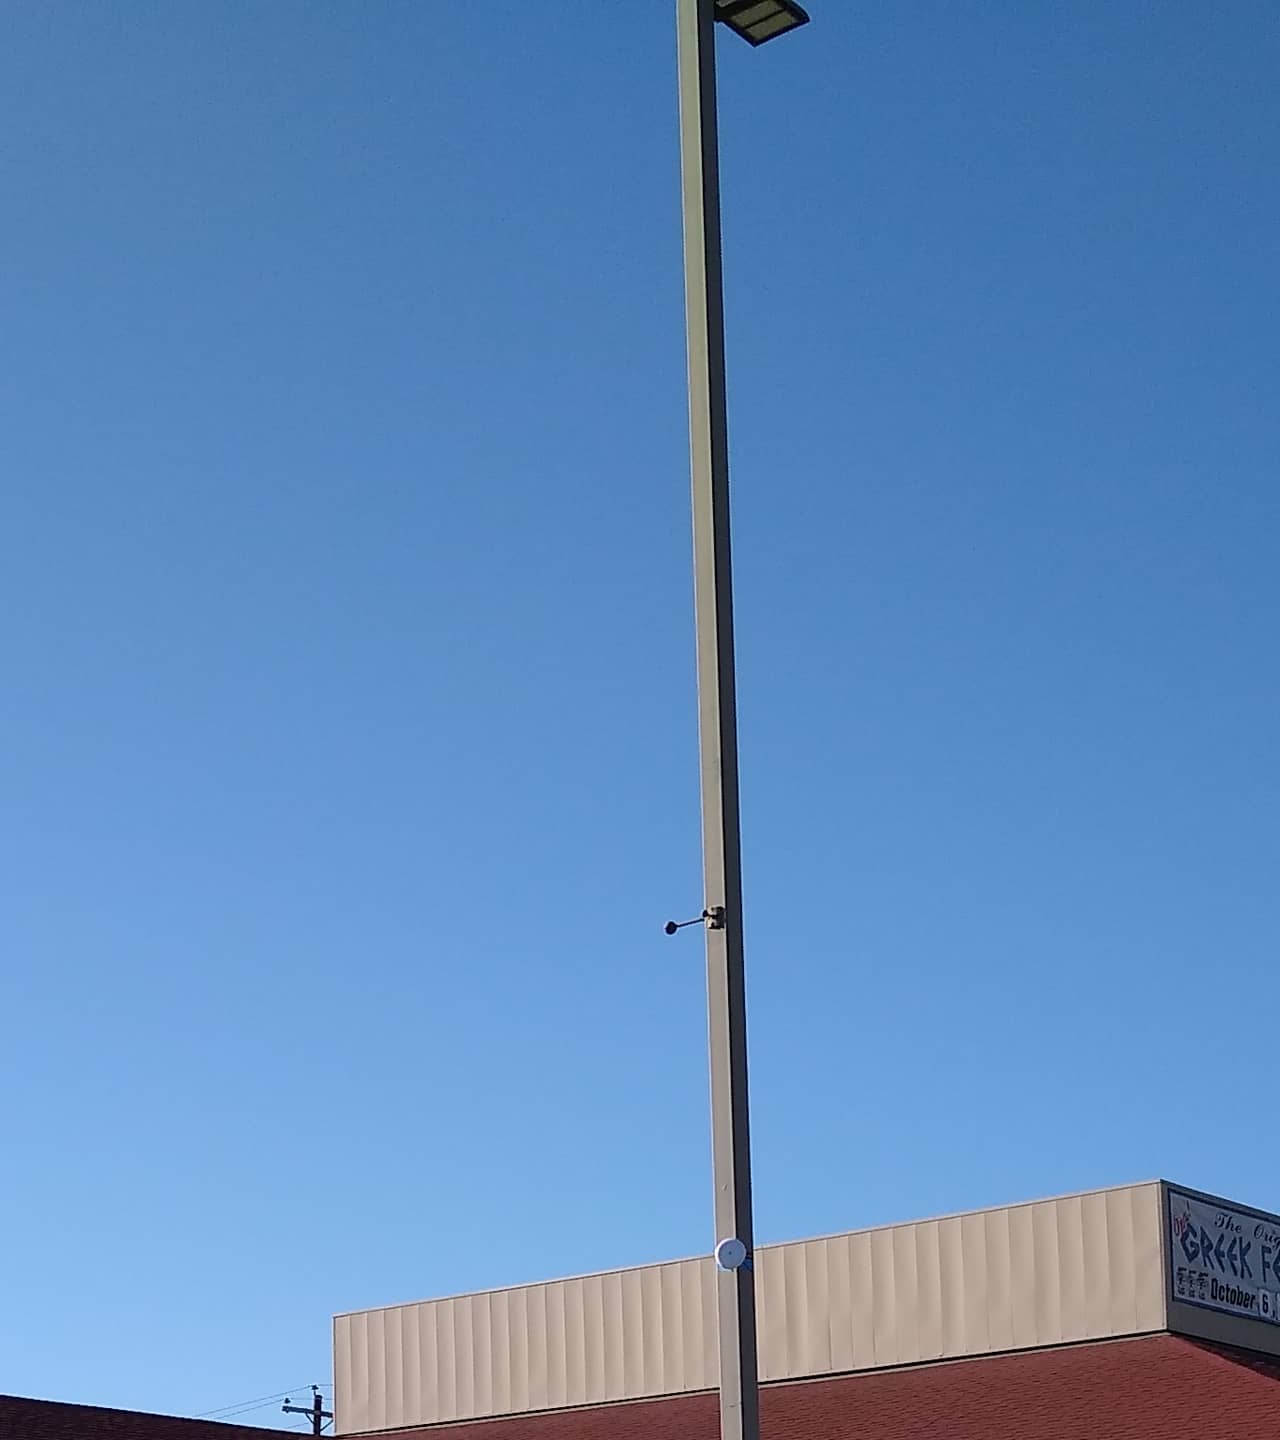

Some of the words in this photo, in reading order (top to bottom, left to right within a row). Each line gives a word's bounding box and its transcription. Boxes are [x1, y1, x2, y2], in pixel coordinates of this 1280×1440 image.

[1214, 1212, 1241, 1234] The
[1180, 1225, 1252, 1280] GREEK
[1210, 1278, 1256, 1309] October
